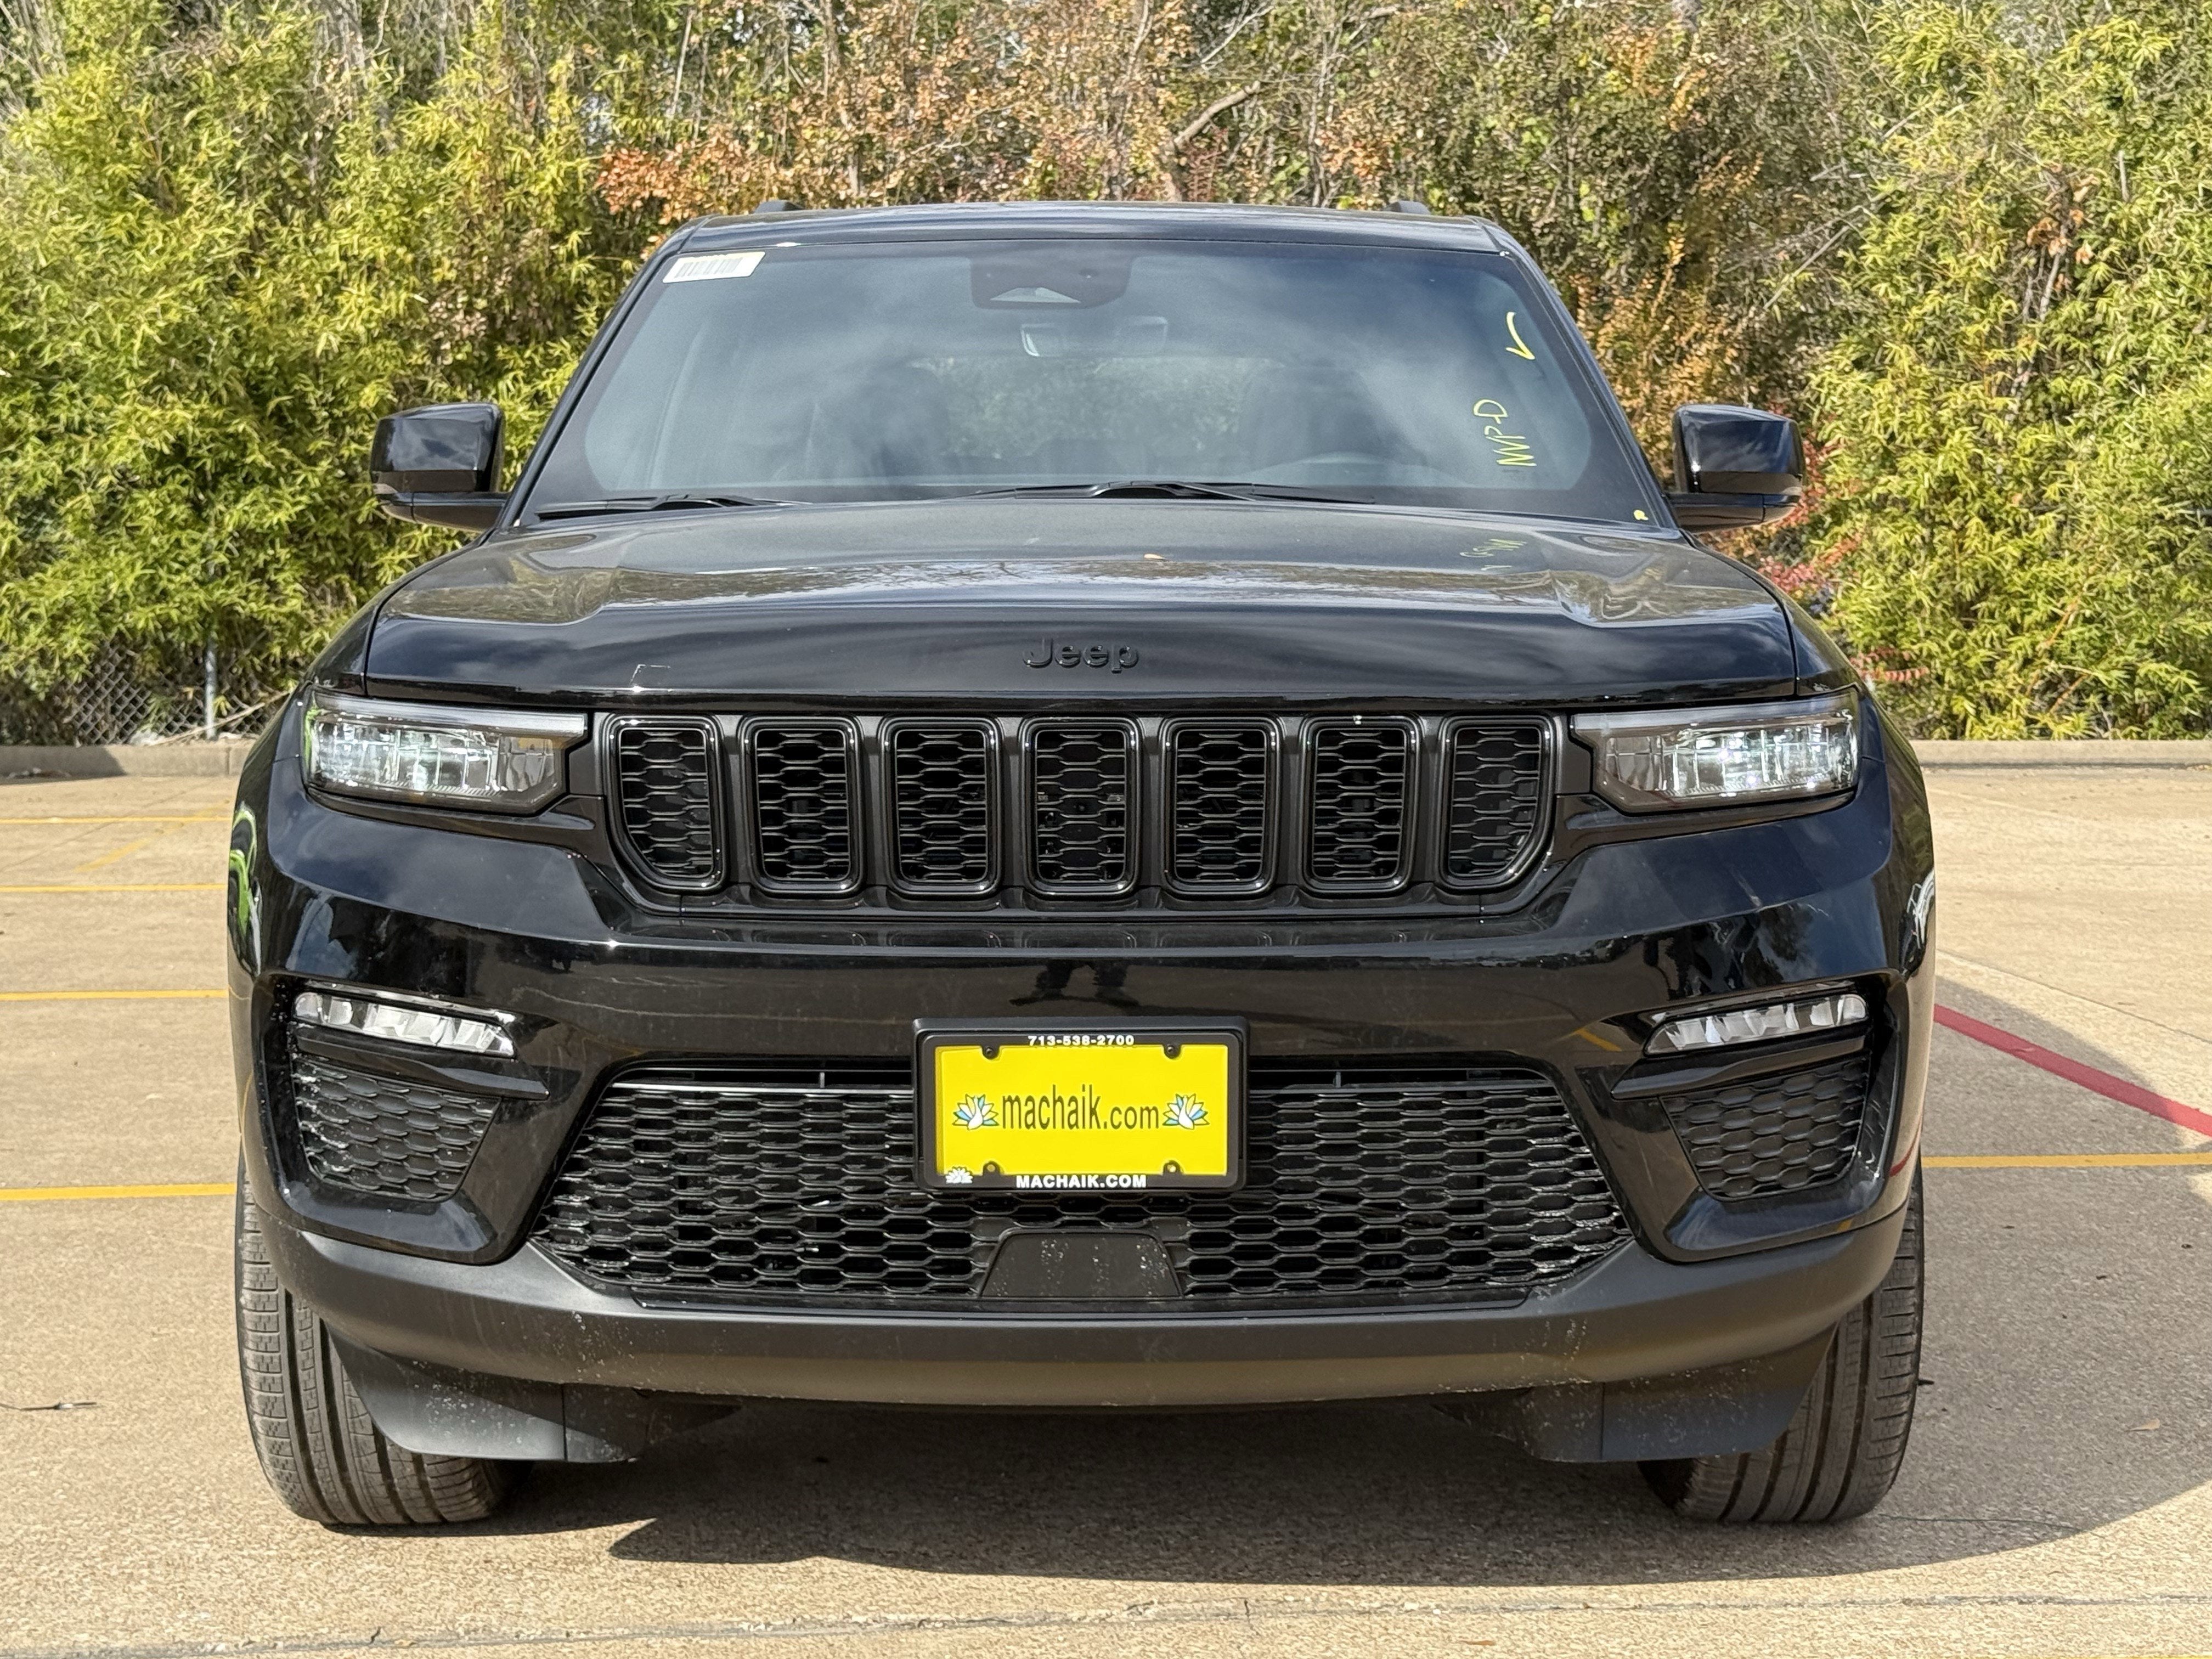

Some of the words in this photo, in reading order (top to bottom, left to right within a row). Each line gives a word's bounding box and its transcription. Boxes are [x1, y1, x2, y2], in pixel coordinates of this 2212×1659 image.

[1023, 638, 1138, 674] Jeep
[1028, 1035, 1135, 1046] 713-538-2700
[1001, 1084, 1160, 1130] machaik.com
[1015, 1174, 1147, 1189] MACHAIK.COM
